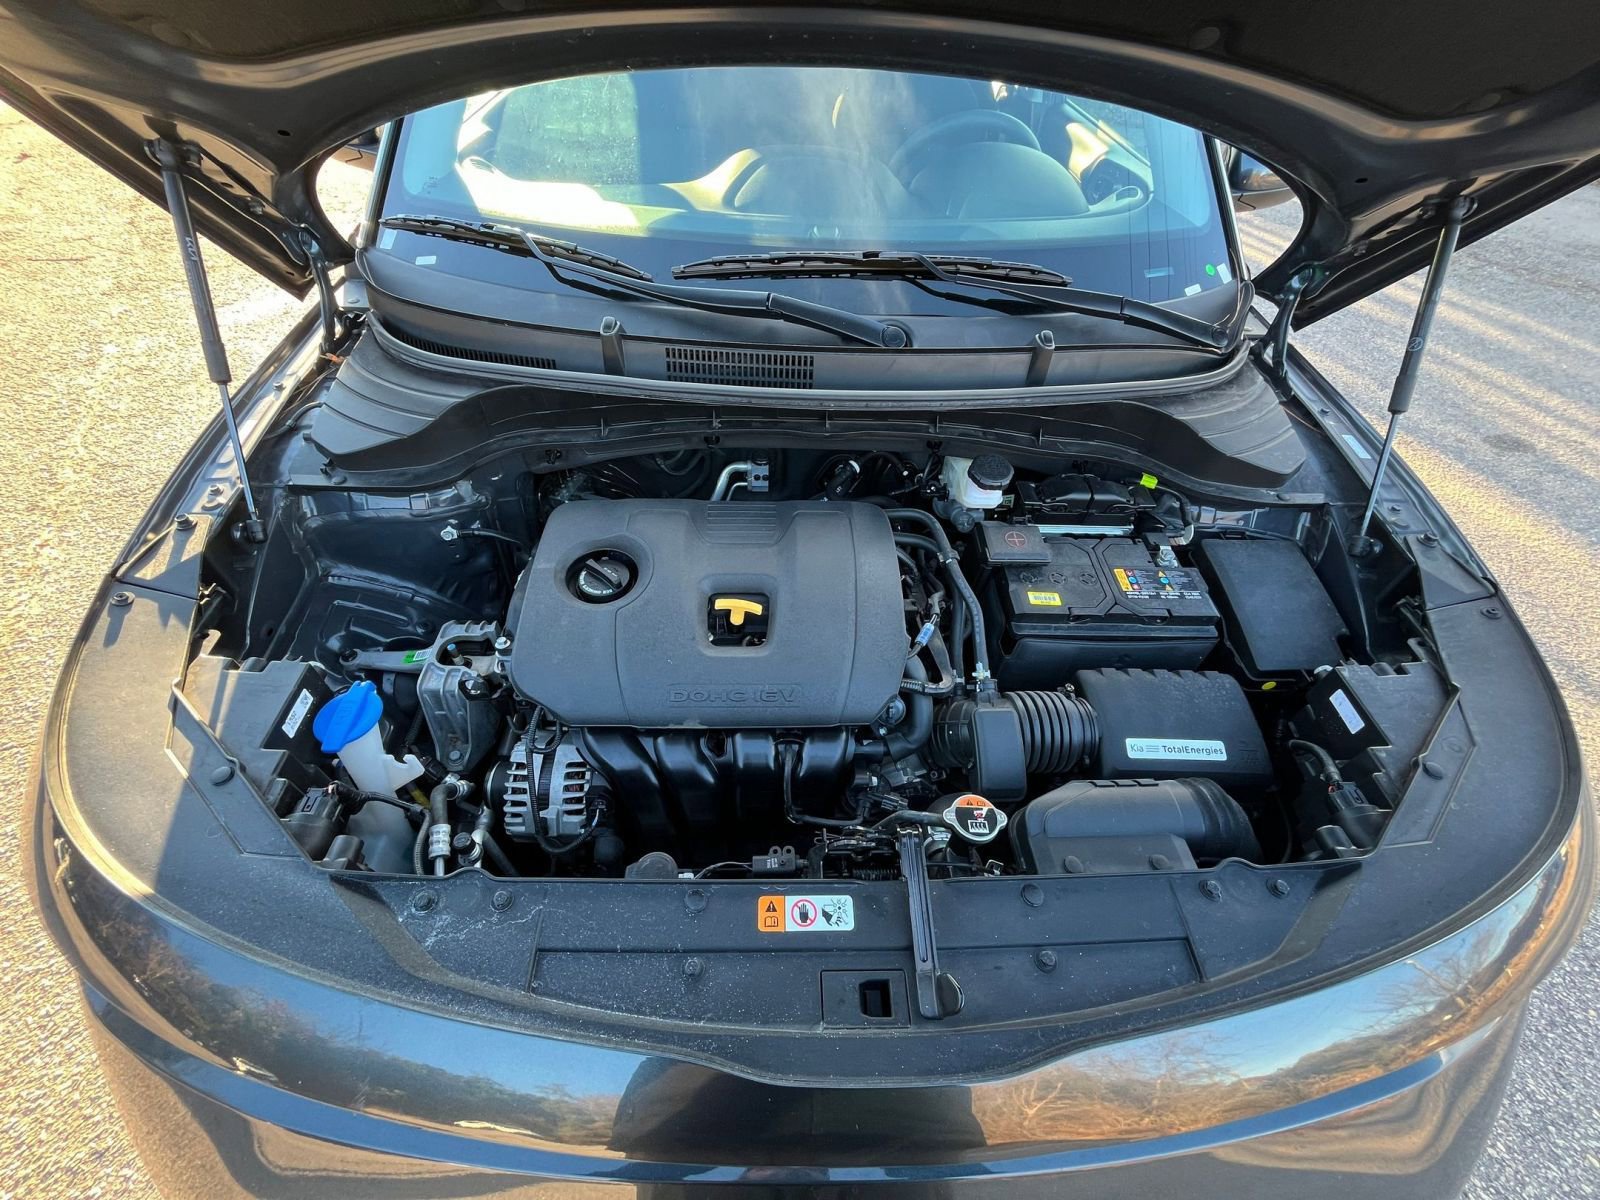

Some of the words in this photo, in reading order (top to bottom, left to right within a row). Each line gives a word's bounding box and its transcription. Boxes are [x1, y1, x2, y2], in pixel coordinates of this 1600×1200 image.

[669, 688, 747, 703] DOHC
[1130, 743, 1144, 753] Kia
[1162, 744, 1224, 756] TotalEnergies
